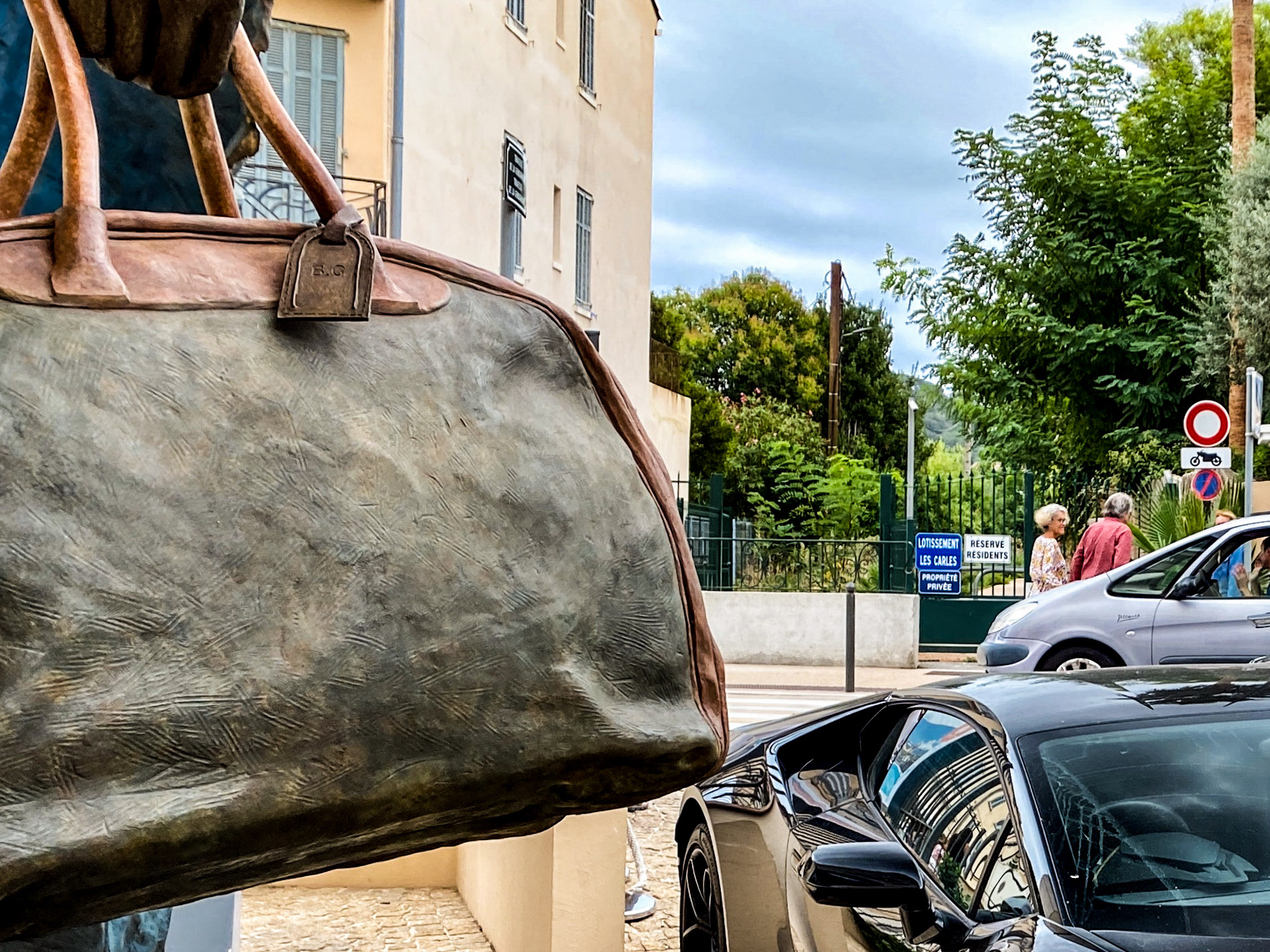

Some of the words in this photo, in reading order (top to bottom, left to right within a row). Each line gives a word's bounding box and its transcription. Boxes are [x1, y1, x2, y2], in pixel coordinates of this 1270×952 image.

[918, 537, 959, 549] LOTISSEMENT
[919, 555, 932, 566] LES
[933, 555, 958, 567] CARLES
[922, 572, 958, 582] PROPRIÉTÉ
[927, 581, 952, 591] PRIVÉE
